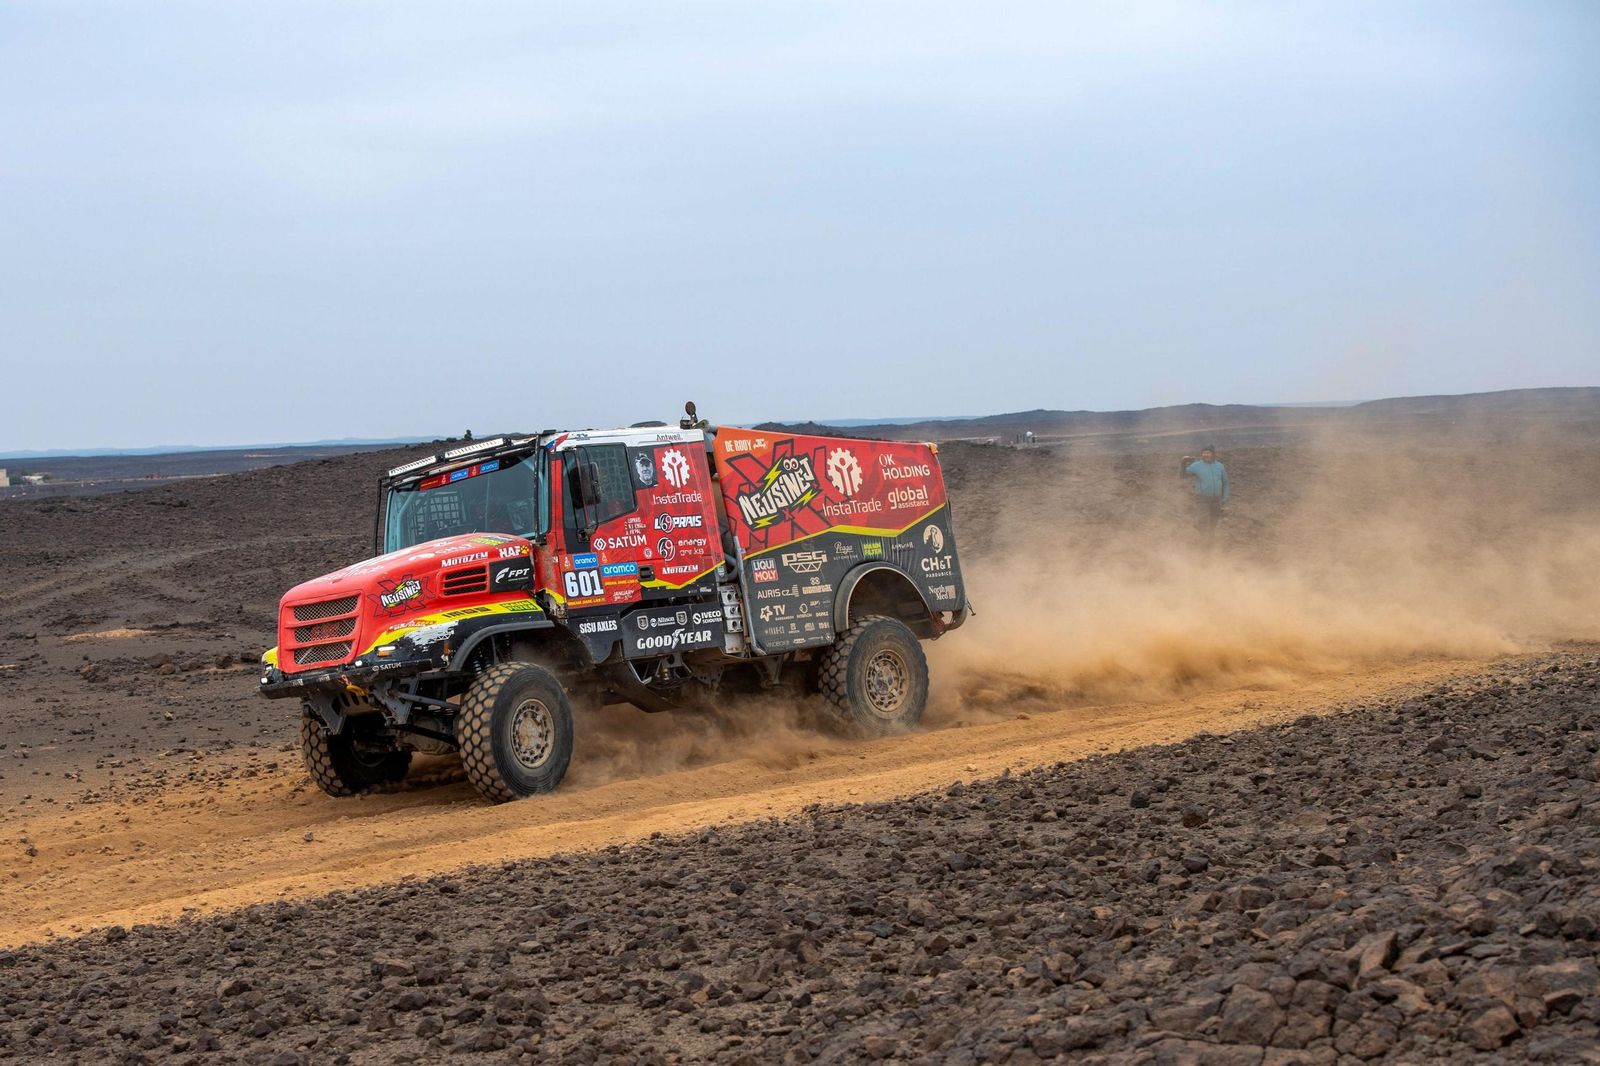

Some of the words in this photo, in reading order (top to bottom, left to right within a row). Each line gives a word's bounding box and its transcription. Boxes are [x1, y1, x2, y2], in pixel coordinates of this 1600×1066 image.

[724, 440, 734, 452] DE
[882, 464, 931, 480] HOLDING
[653, 492, 702, 505] InstaTrade
[888, 485, 928, 510] global
[822, 497, 882, 517] InstaTrade
[898, 499, 930, 509] assistance
[608, 534, 647, 549] SATUM
[499, 546, 521, 558] HAF
[603, 564, 636, 574] aramco
[753, 560, 775, 570] LIQUI
[921, 555, 952, 571] CH&T
[508, 568, 530, 578] FPT
[755, 570, 776, 581] MOLY
[564, 569, 604, 597] 601
[757, 588, 781, 599] AURIS
[701, 610, 721, 618] IVECO
[773, 604, 785, 616] TV
[579, 622, 596, 634] SISU
[597, 620, 618, 632] AXLES
